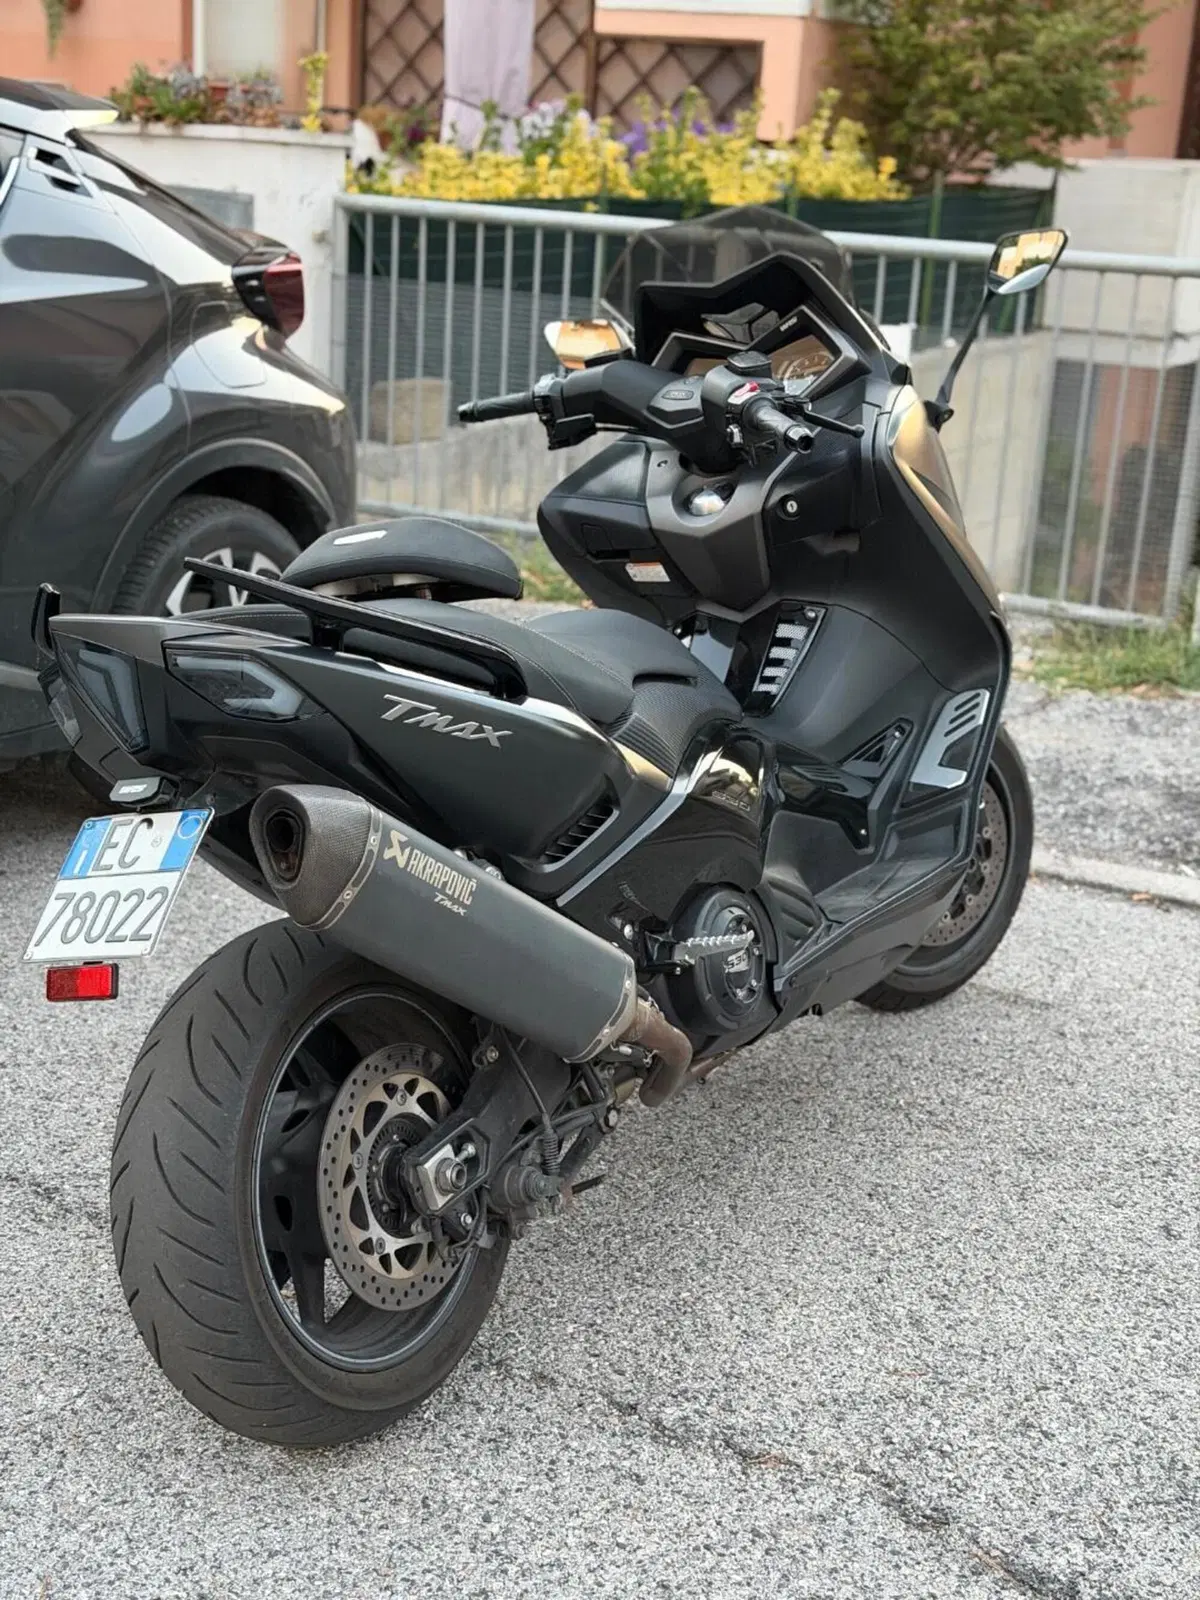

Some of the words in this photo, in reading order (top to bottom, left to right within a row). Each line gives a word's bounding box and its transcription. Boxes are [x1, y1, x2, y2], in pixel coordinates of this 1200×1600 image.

[380, 693, 512, 748] TMAX
[92, 818, 154, 872] EC
[34, 885, 170, 948] 78022
